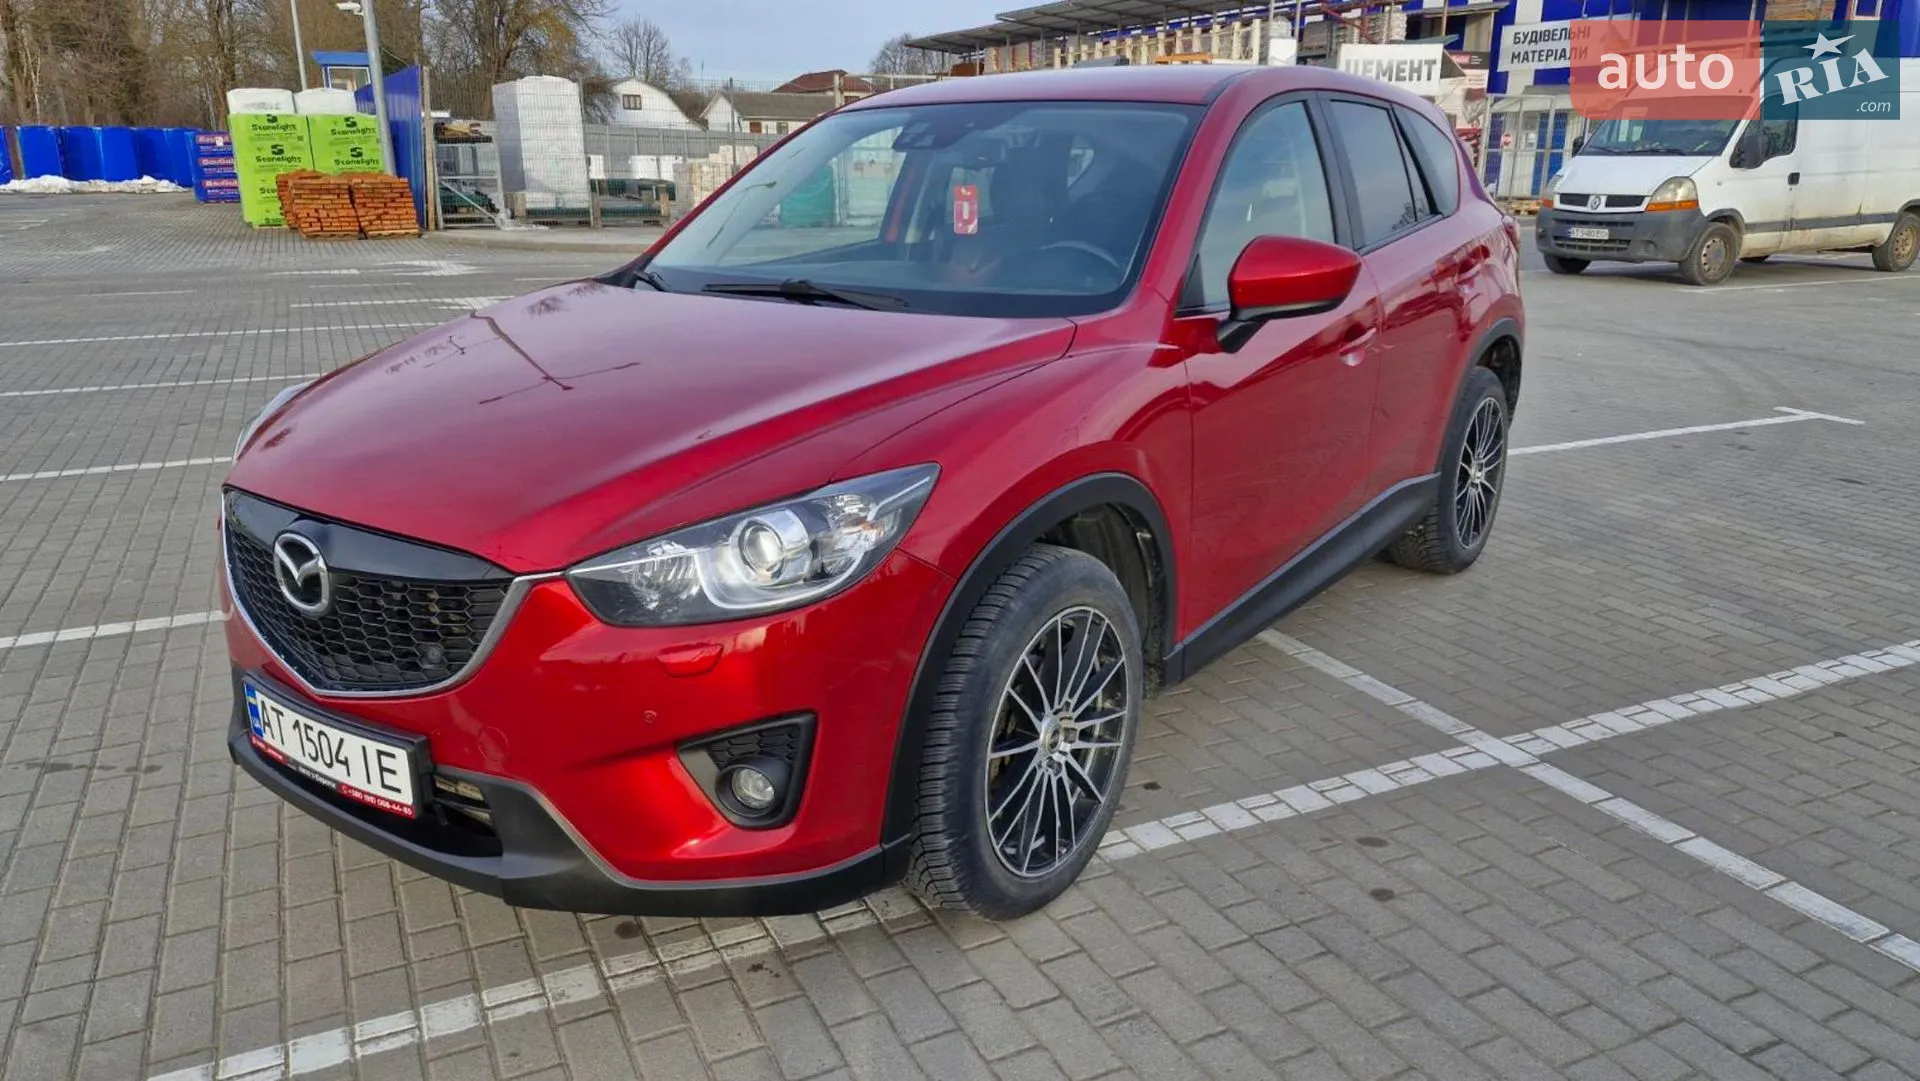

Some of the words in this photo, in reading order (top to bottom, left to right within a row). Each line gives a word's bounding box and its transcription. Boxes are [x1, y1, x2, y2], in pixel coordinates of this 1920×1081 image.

[1513, 25, 1592, 46] БУДІВЕЛЬНІ
[1510, 46, 1589, 65] МАТЕРІАЛИ
[261, 700, 285, 746] AT
[292, 719, 351, 777] 1504
[361, 745, 402, 794] IE
